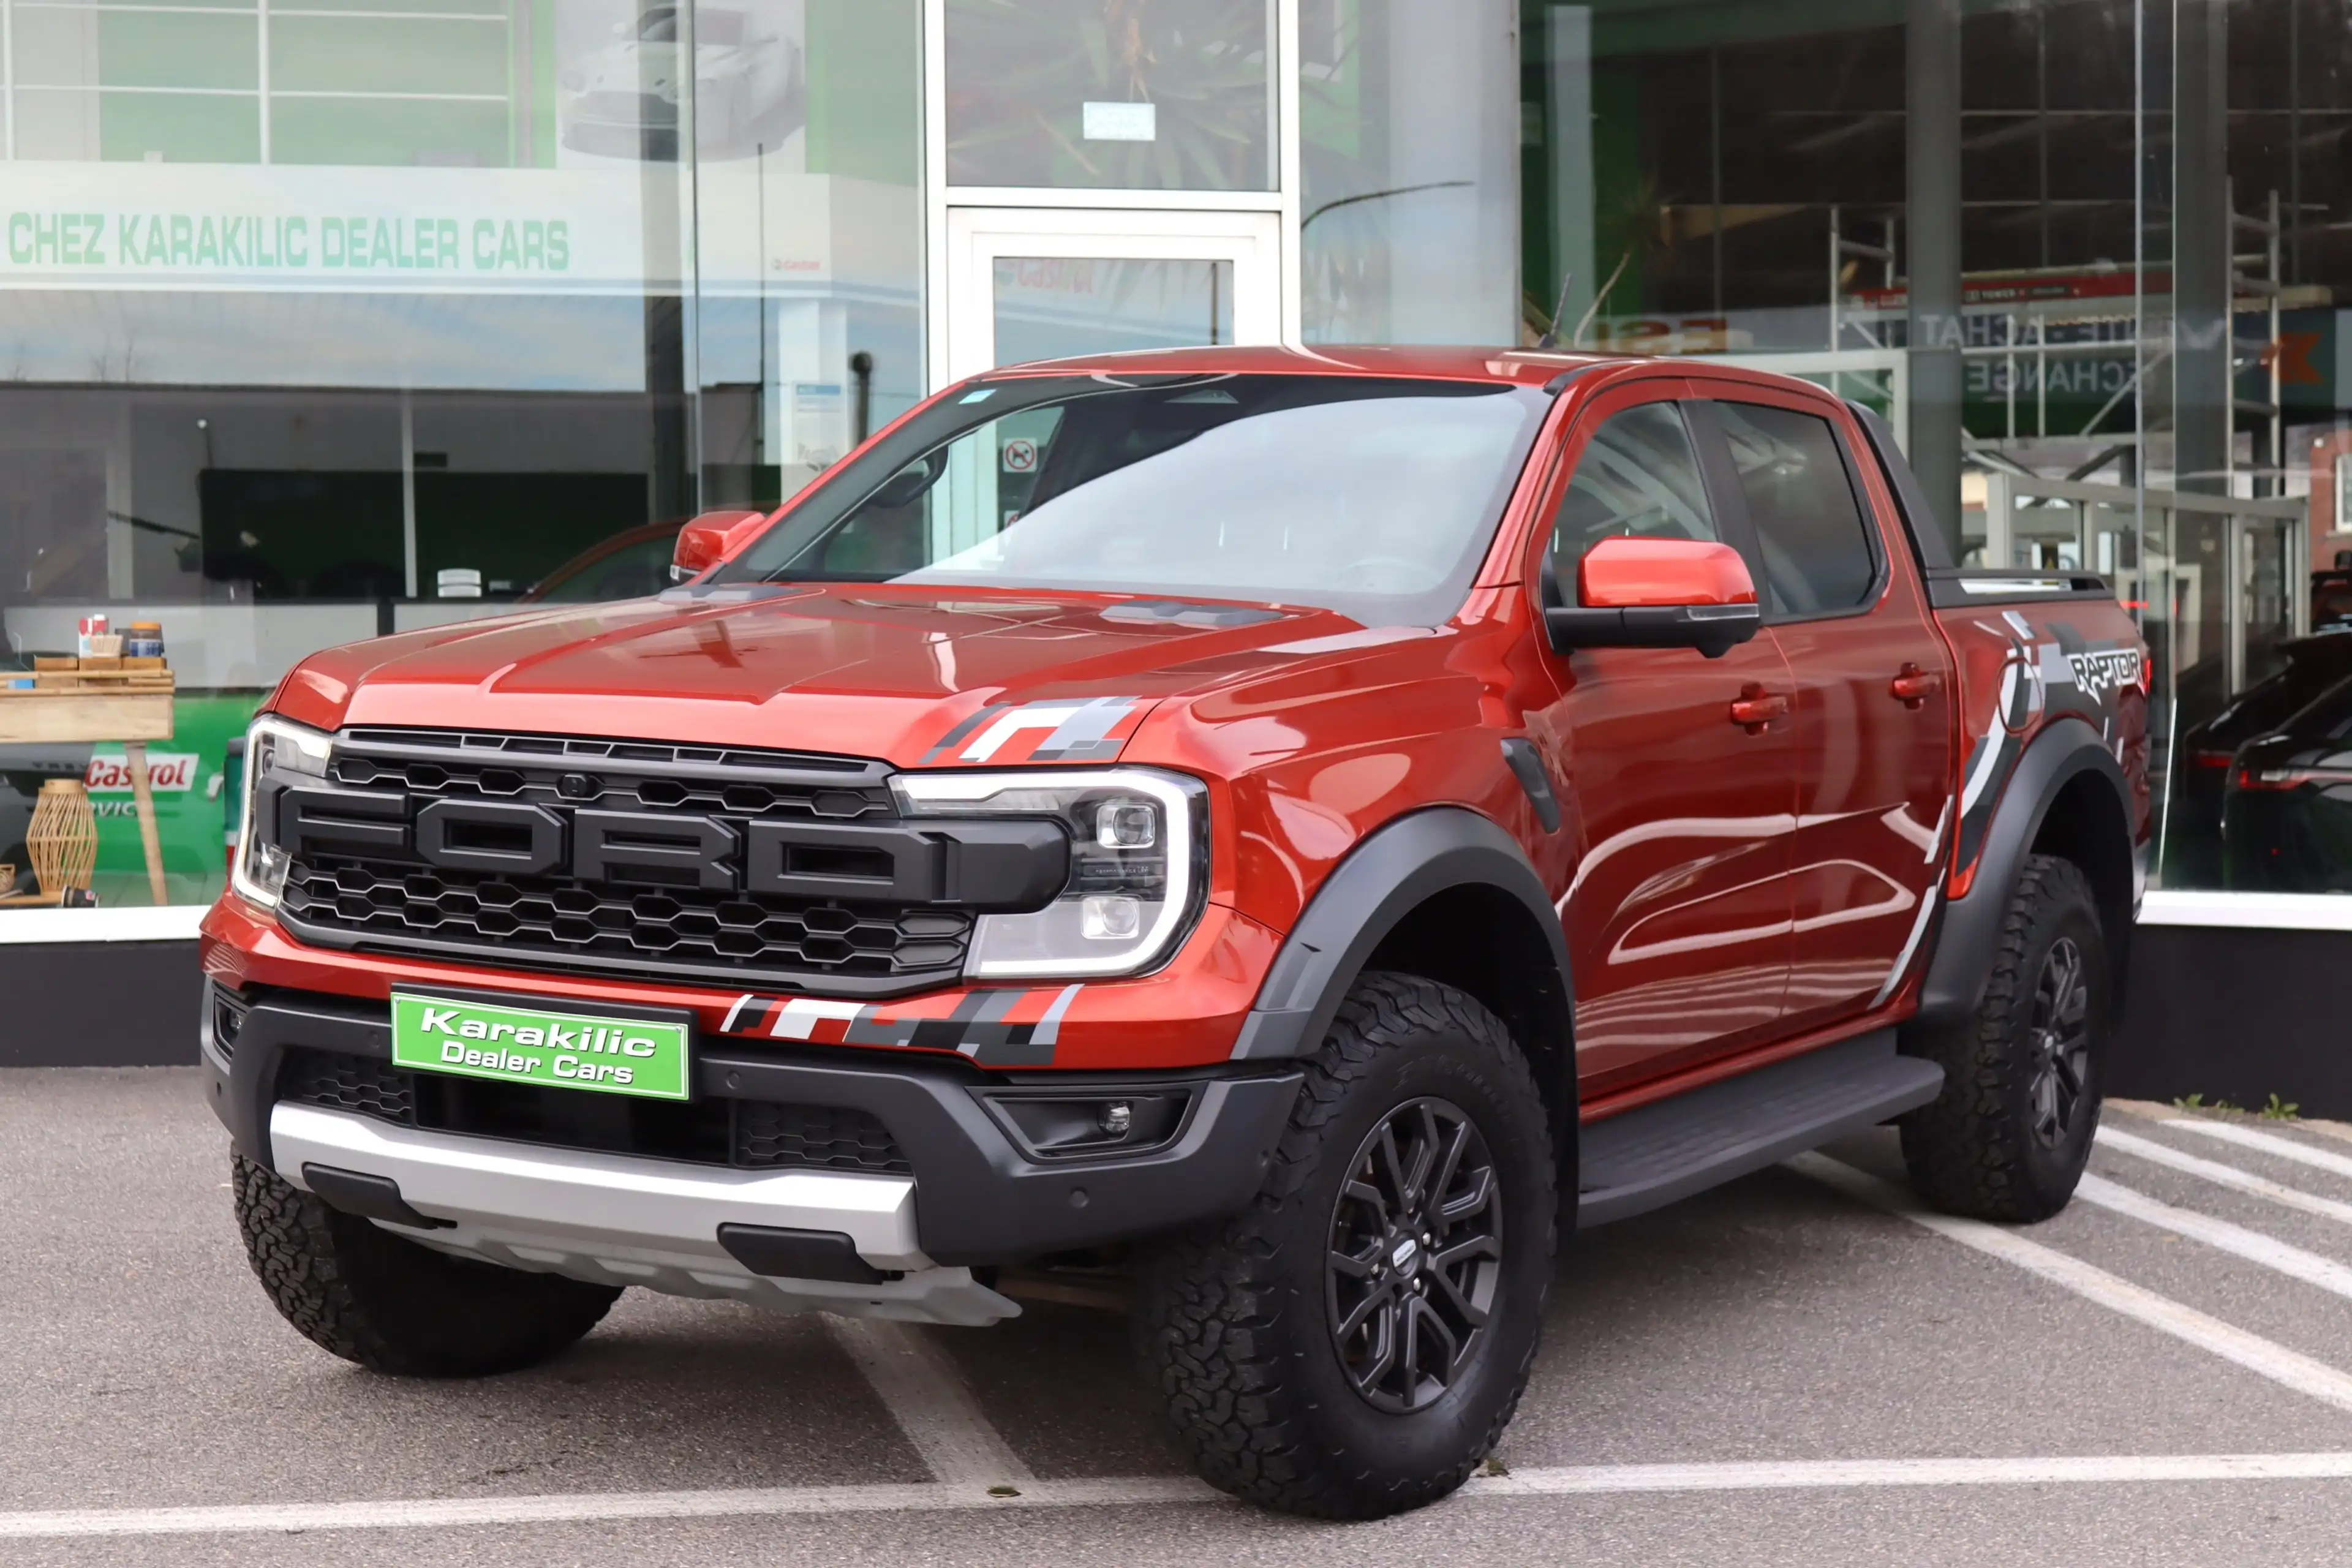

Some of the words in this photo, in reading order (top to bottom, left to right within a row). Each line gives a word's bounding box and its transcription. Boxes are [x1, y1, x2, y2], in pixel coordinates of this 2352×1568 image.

[8, 212, 105, 265] CHEZ
[119, 214, 308, 268] KARAKILIC
[321, 217, 460, 270] DEALER
[473, 219, 570, 271] CARS
[2067, 648, 2146, 706] RAPTOR
[85, 759, 187, 788] Casrol
[280, 785, 948, 903] FORD
[420, 1008, 657, 1057] Karakilic
[441, 1040, 541, 1073] Dealer
[552, 1055, 634, 1084] Cars
